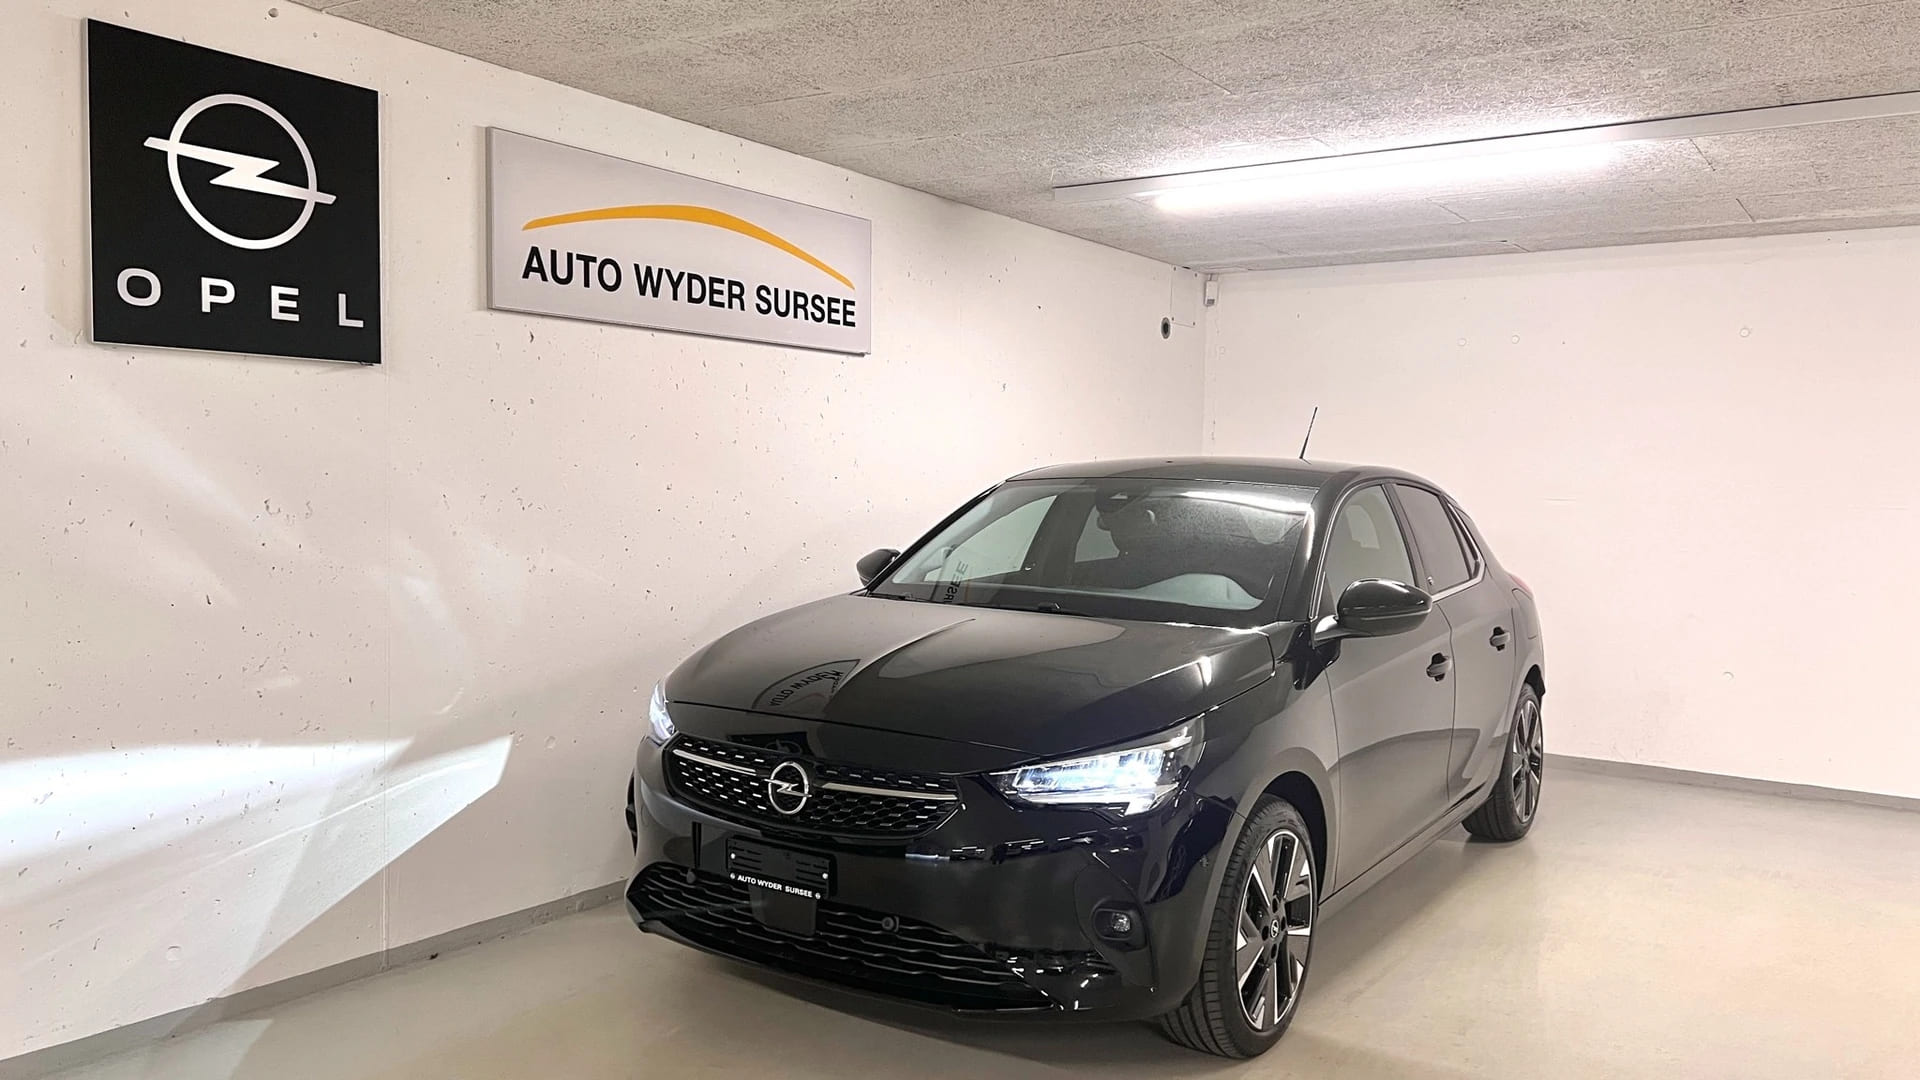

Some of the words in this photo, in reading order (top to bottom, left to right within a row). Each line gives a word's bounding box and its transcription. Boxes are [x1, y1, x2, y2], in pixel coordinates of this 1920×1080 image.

[116, 267, 364, 328] OPEL
[521, 245, 622, 293] AUTO
[633, 263, 746, 312] WYDER
[755, 284, 856, 328] SURSEE
[737, 874, 757, 885] AUTO
[757, 879, 783, 891] WYDER
[784, 885, 813, 898] SURSEE
